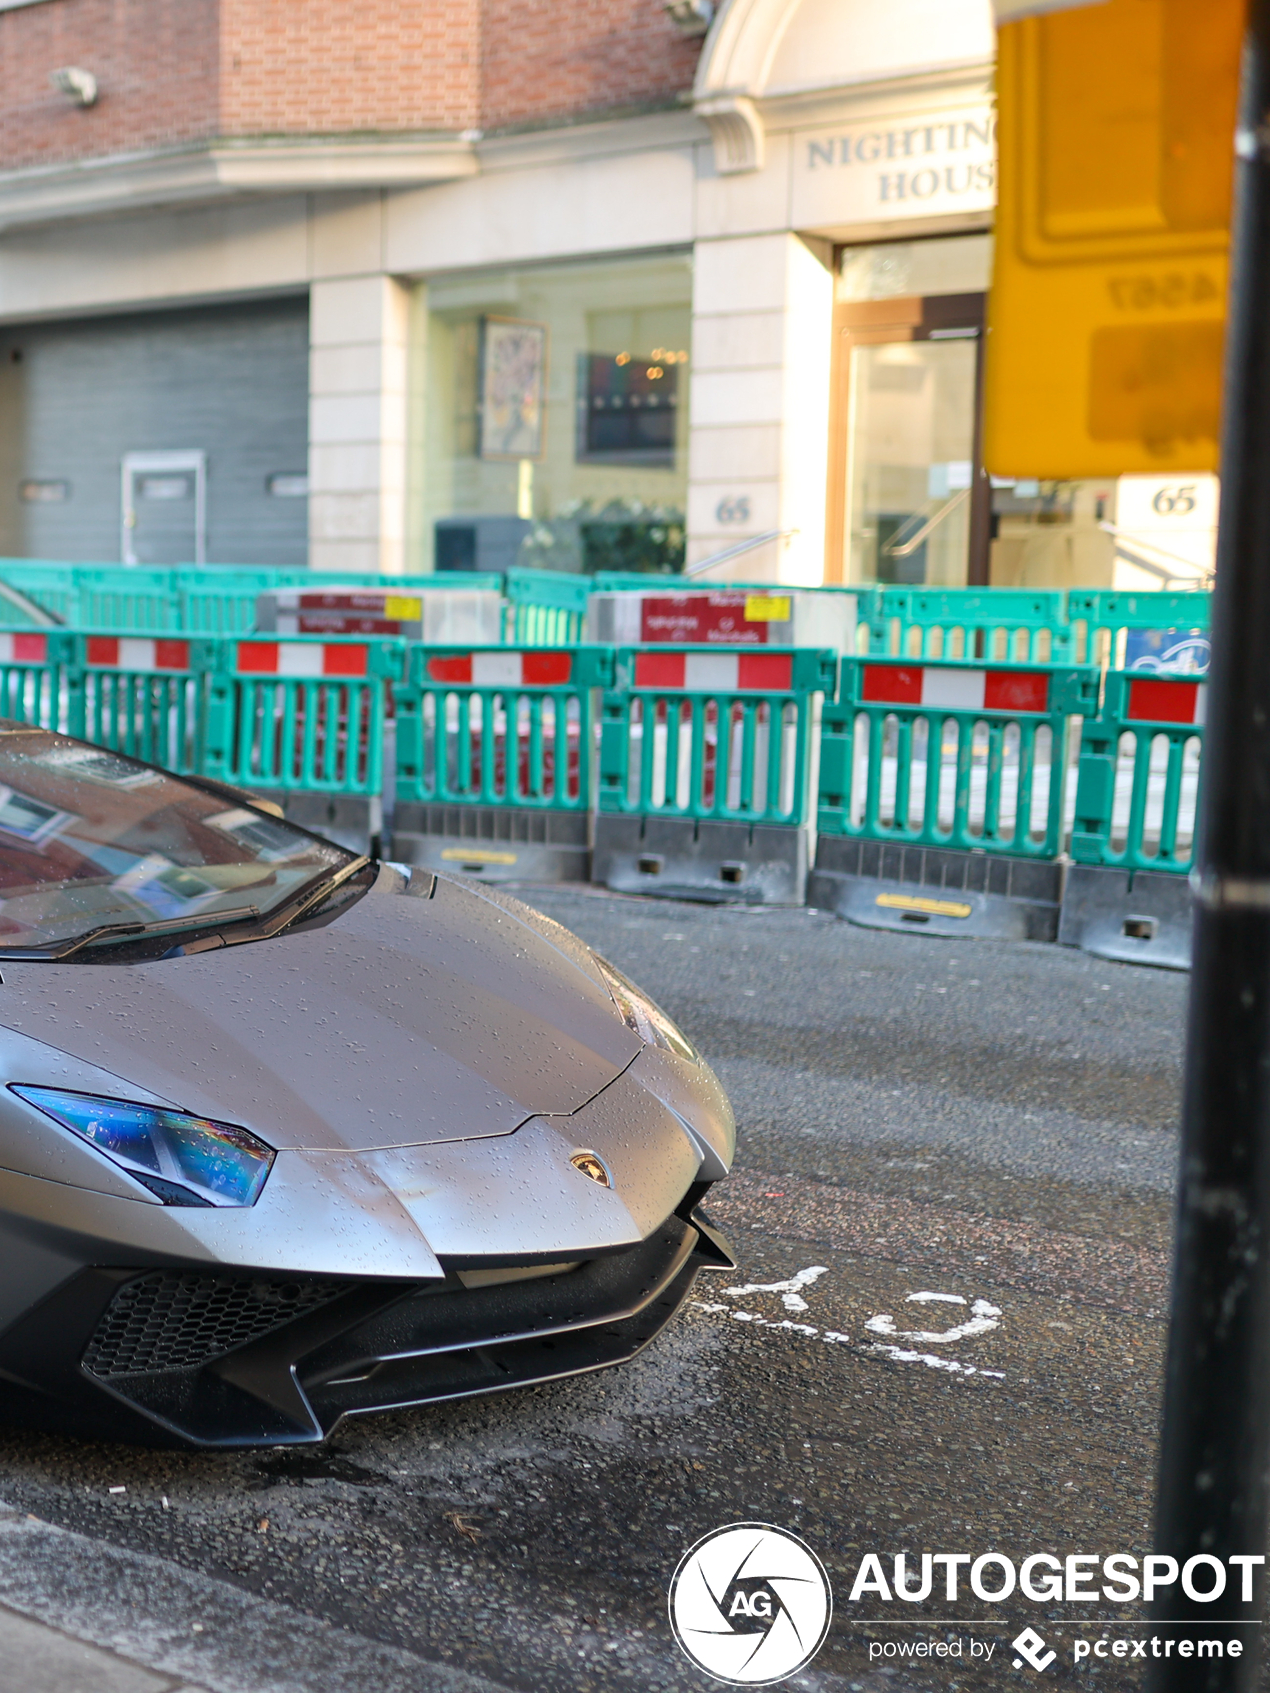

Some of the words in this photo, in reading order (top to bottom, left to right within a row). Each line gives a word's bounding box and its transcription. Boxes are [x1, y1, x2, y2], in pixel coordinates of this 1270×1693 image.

[807, 114, 998, 169] NIGHTIN
[879, 163, 997, 201] HOUS
[715, 495, 750, 525] 65
[1154, 485, 1196, 514] 65
